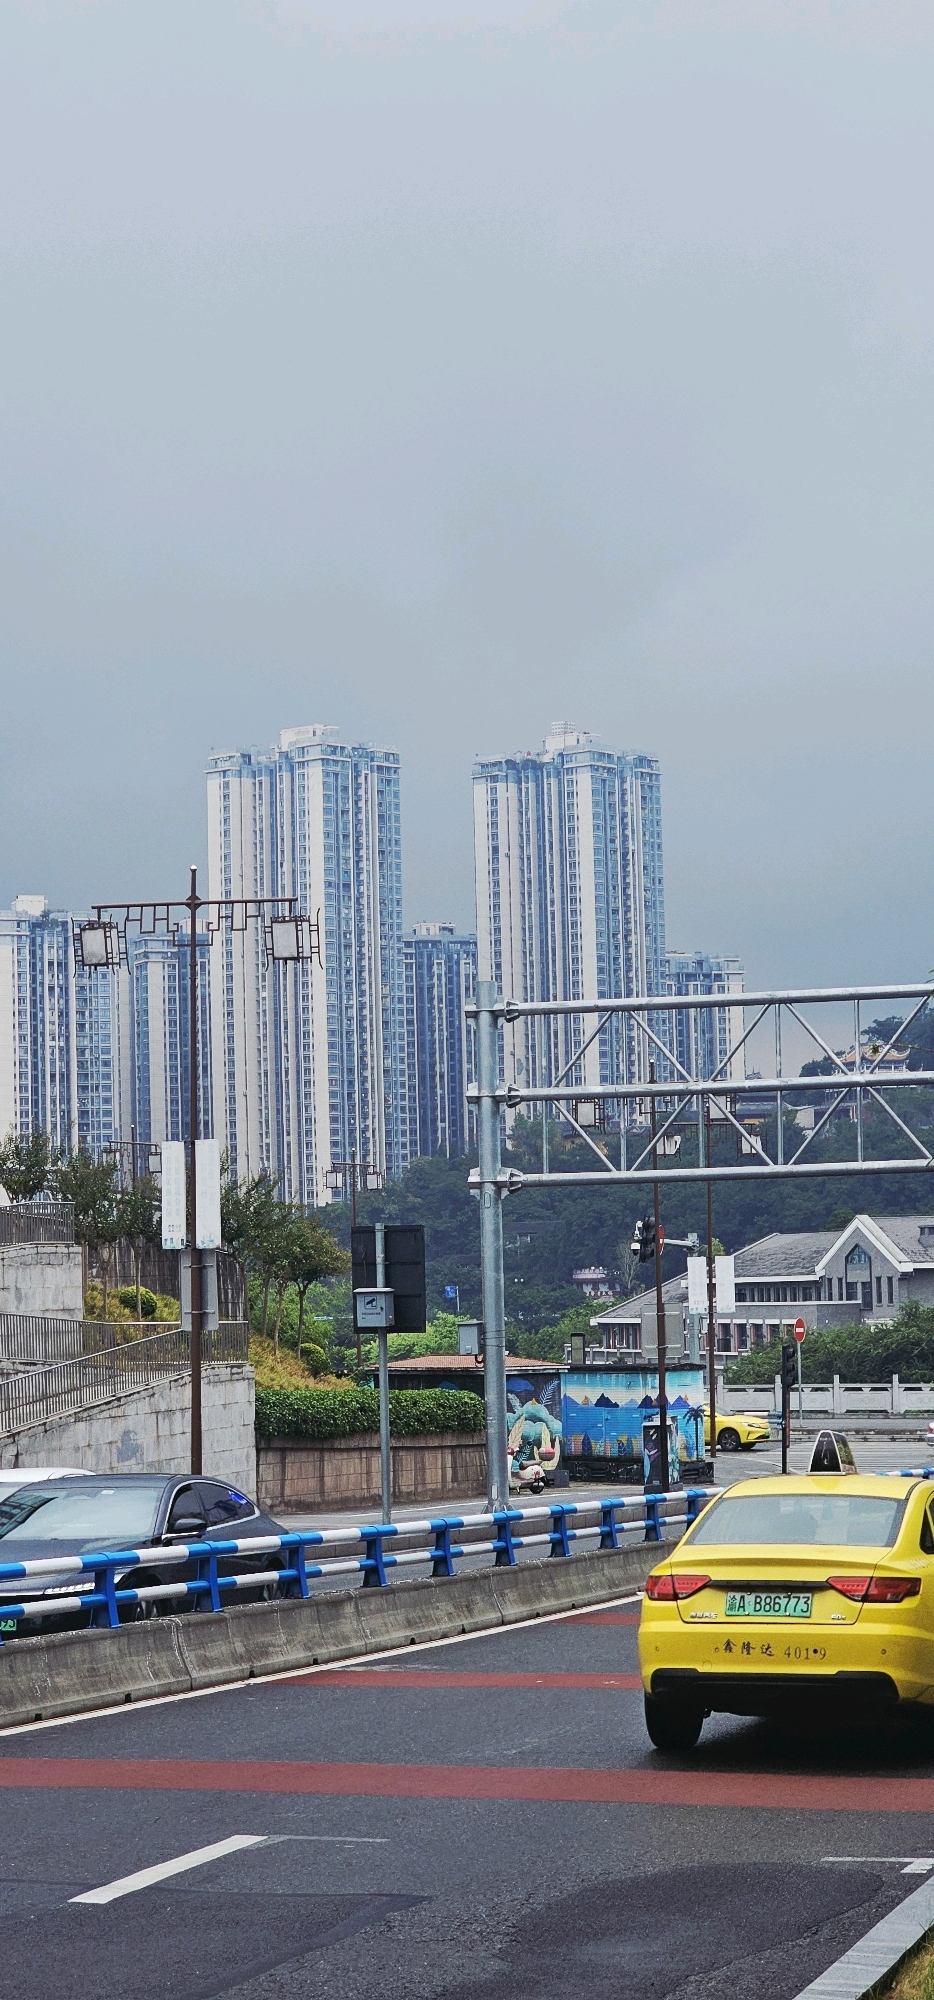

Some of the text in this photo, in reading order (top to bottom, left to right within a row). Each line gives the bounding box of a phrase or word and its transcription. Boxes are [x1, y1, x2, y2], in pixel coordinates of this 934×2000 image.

[754, 1595, 810, 1613] B86773
[723, 1638, 774, 1656] 鑫隆达
